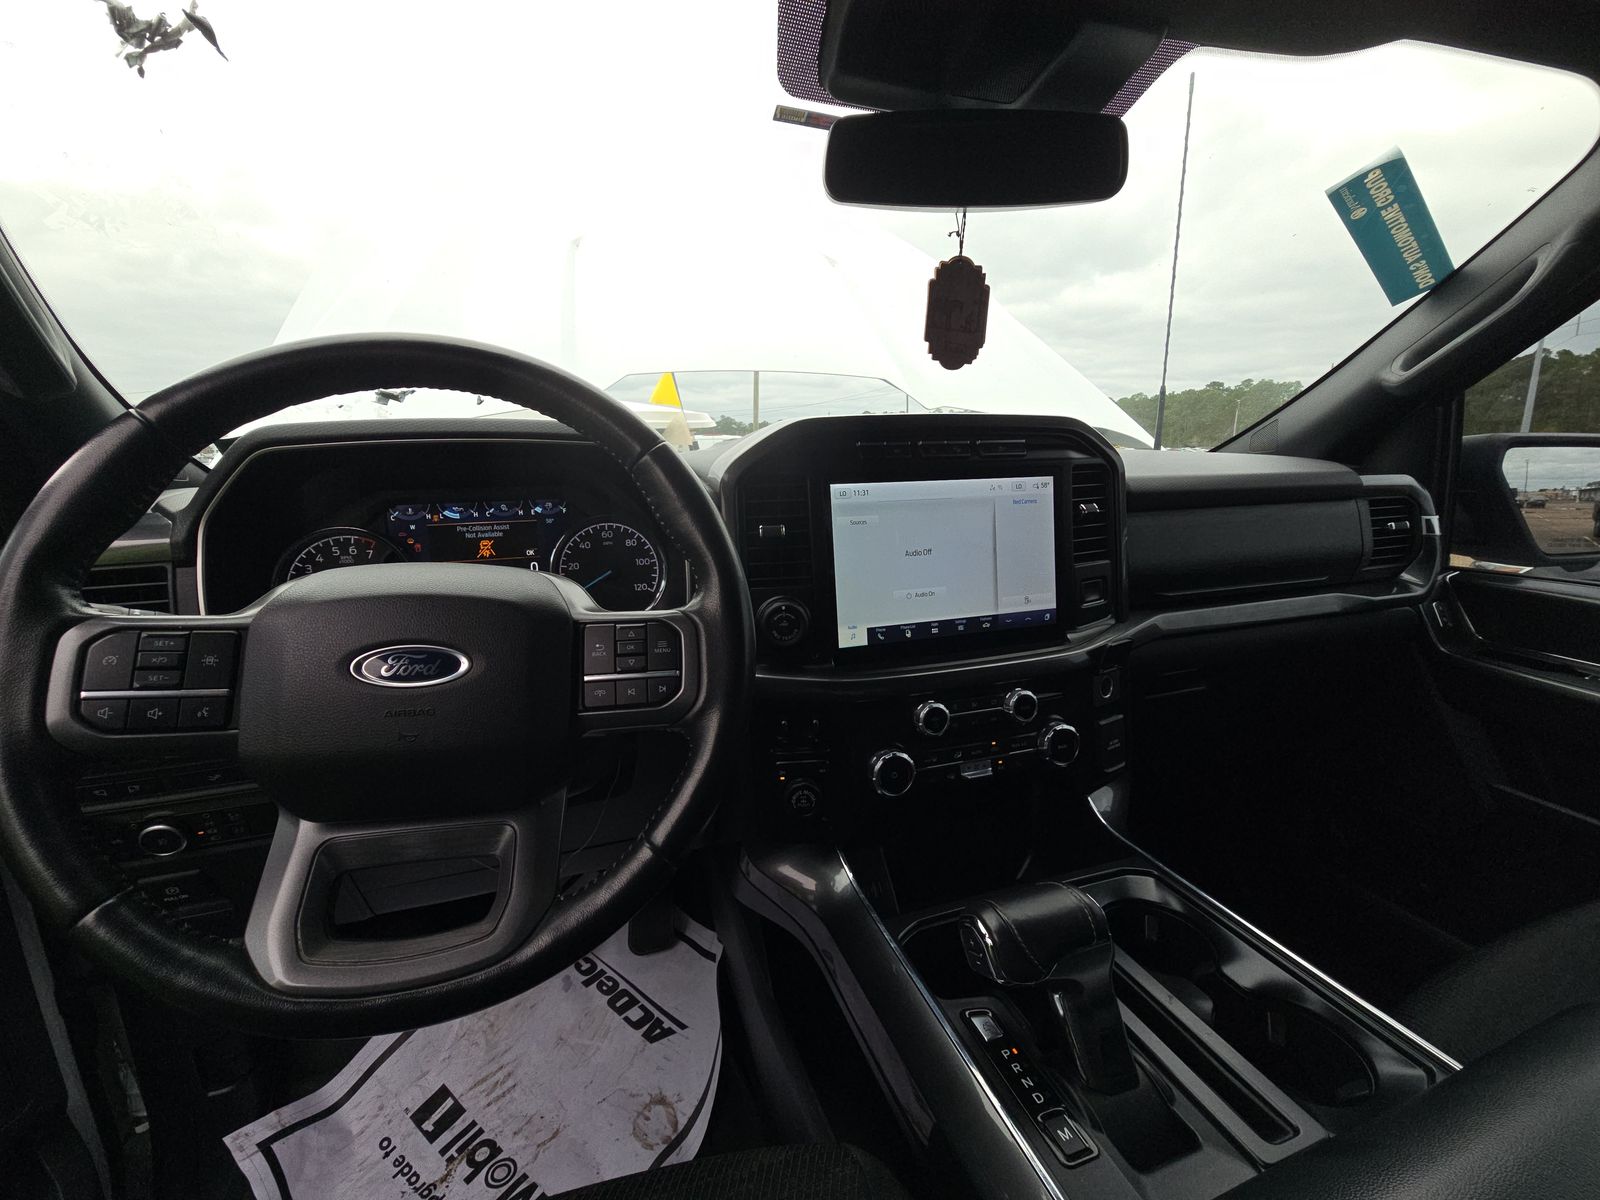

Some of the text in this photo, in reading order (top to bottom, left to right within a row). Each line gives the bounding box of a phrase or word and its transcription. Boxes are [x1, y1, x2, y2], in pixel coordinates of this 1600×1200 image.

[853, 489, 869, 497] 11:31
[456, 523, 510, 532] Pre-Collision Assist
[477, 530, 504, 538] Available
[601, 530, 614, 538] 60
[578, 541, 591, 549] 40
[625, 539, 637, 547] 80
[331, 546, 340, 556] 5
[348, 545, 357, 555] 6
[365, 550, 374, 559] 7
[905, 548, 932, 557] Audio Off
[315, 554, 324, 563] 4
[635, 558, 650, 567] 100
[304, 564, 313, 575] 3
[568, 562, 580, 571] 20
[633, 584, 648, 592] 120
[380, 653, 443, 678] Ford
[384, 707, 436, 718] AIRBAG
[574, 956, 677, 1044] ACDelc
[1001, 1048, 1044, 1104] P R N D
[1056, 1126, 1074, 1142] M
[378, 1136, 397, 1160] to
